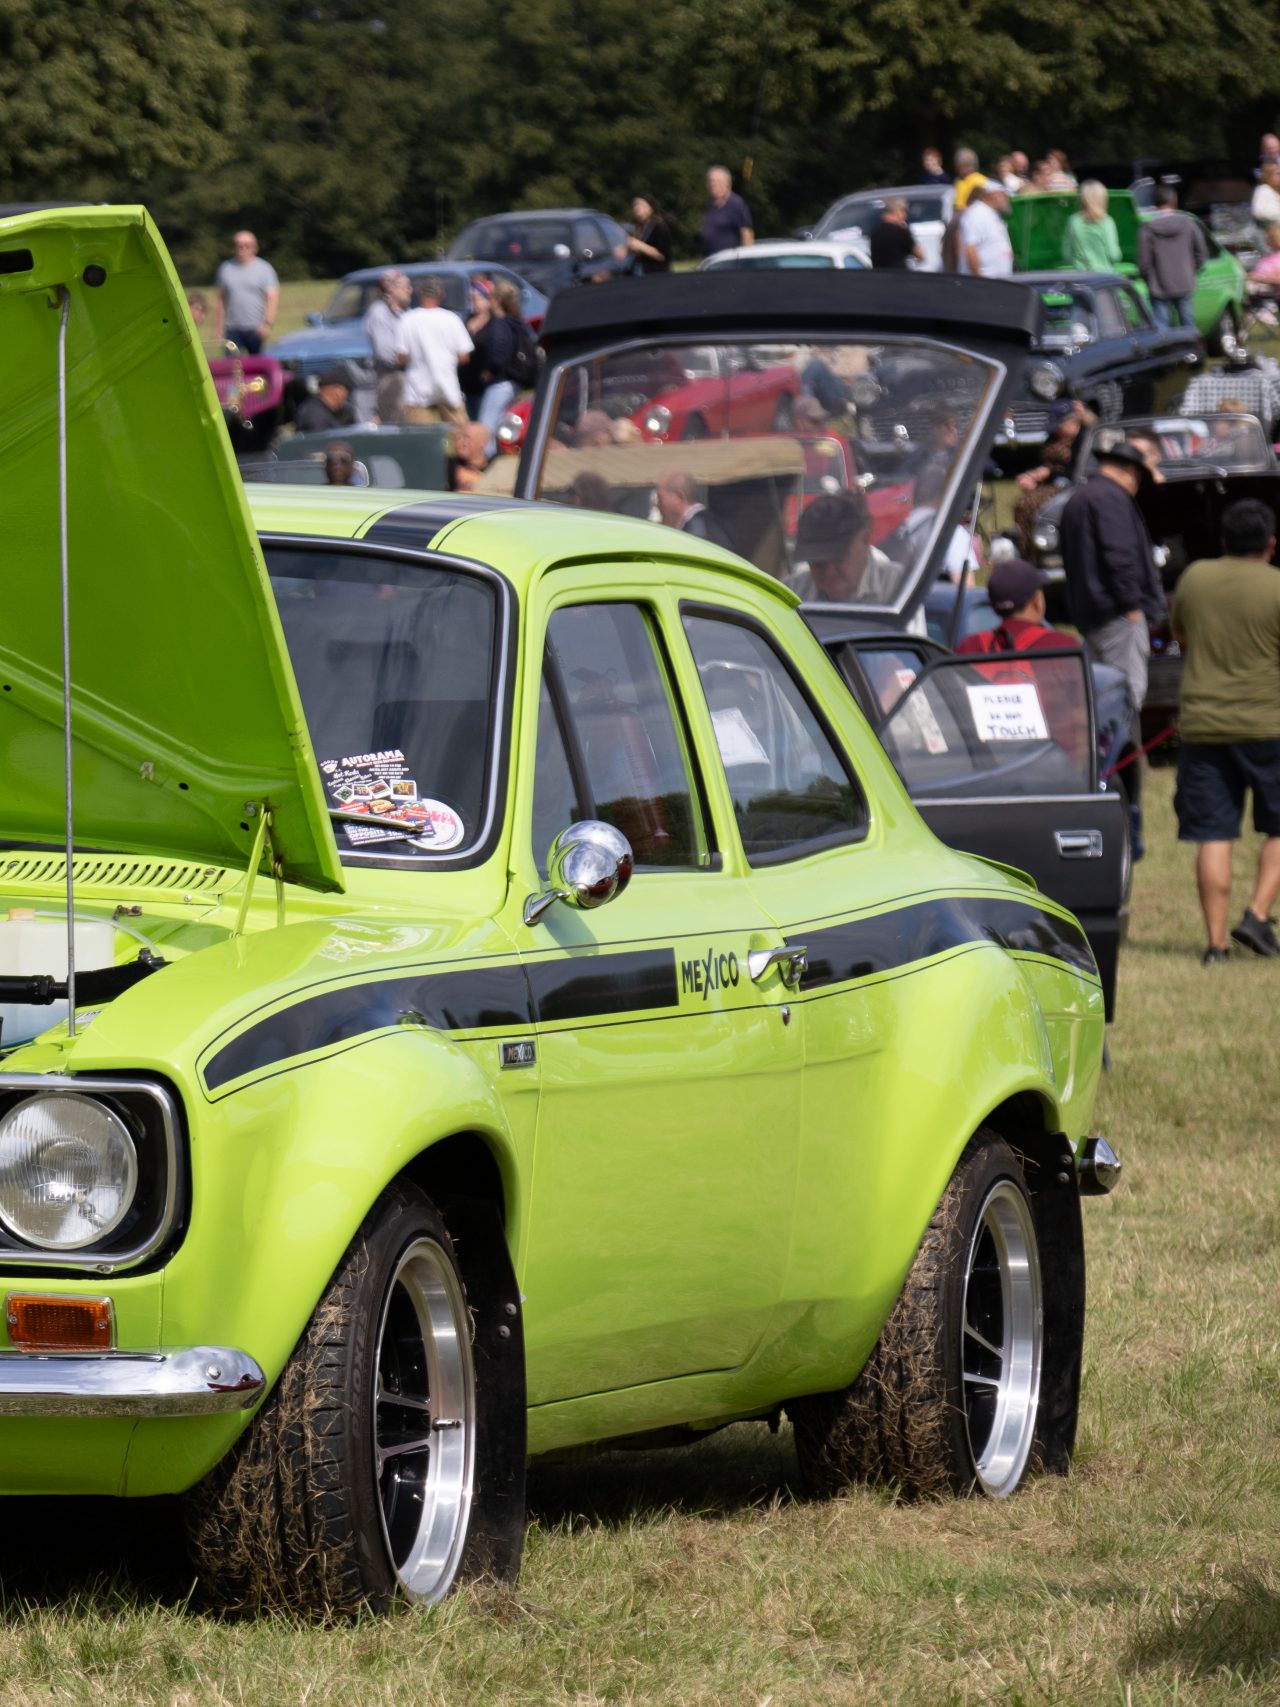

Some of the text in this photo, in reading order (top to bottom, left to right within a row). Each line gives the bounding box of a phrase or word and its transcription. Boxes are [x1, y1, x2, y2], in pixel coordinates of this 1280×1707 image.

[987, 725, 1038, 740] TOUCH
[341, 749, 404, 767] AUTORAMA
[681, 947, 740, 1001] MEXICO
